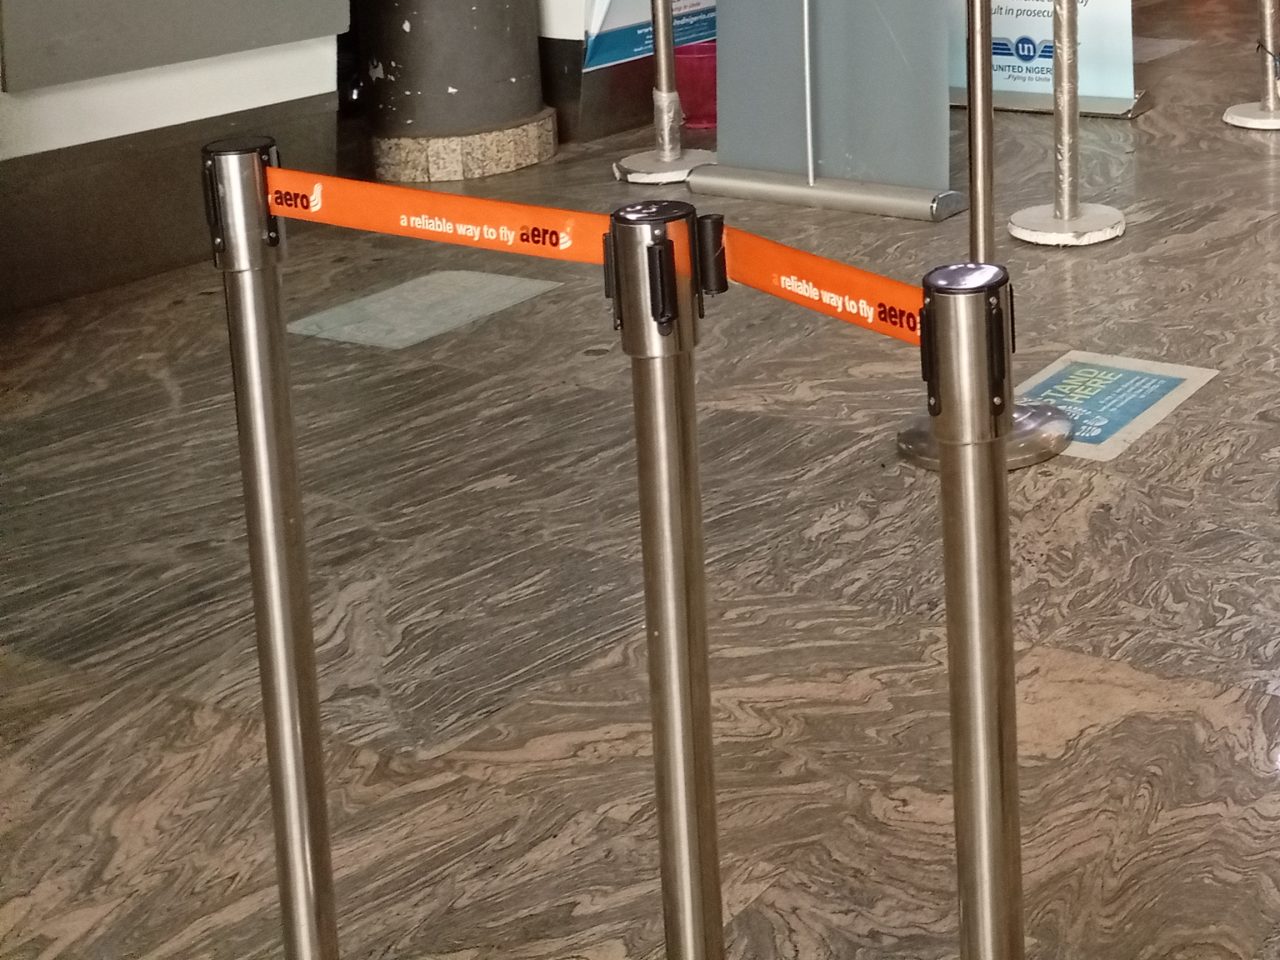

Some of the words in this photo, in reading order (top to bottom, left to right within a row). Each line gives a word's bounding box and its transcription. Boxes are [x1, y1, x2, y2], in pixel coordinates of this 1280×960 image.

[1004, 6, 1014, 16] in
[1015, 7, 1053, 19] prosecu
[992, 64, 1024, 74] UNITED
[1025, 66, 1053, 76] NIGER
[274, 188, 310, 210] aero
[400, 215, 408, 226] a
[410, 215, 454, 234] reliable
[455, 224, 481, 240] way
[483, 225, 497, 240] to
[499, 227, 516, 245] fly
[519, 224, 560, 248] aero
[780, 275, 820, 300] reliable
[820, 289, 844, 313] way
[844, 295, 858, 314] to
[858, 299, 875, 324] fly
[877, 302, 917, 332] aero
[1064, 371, 1123, 404] HERE
